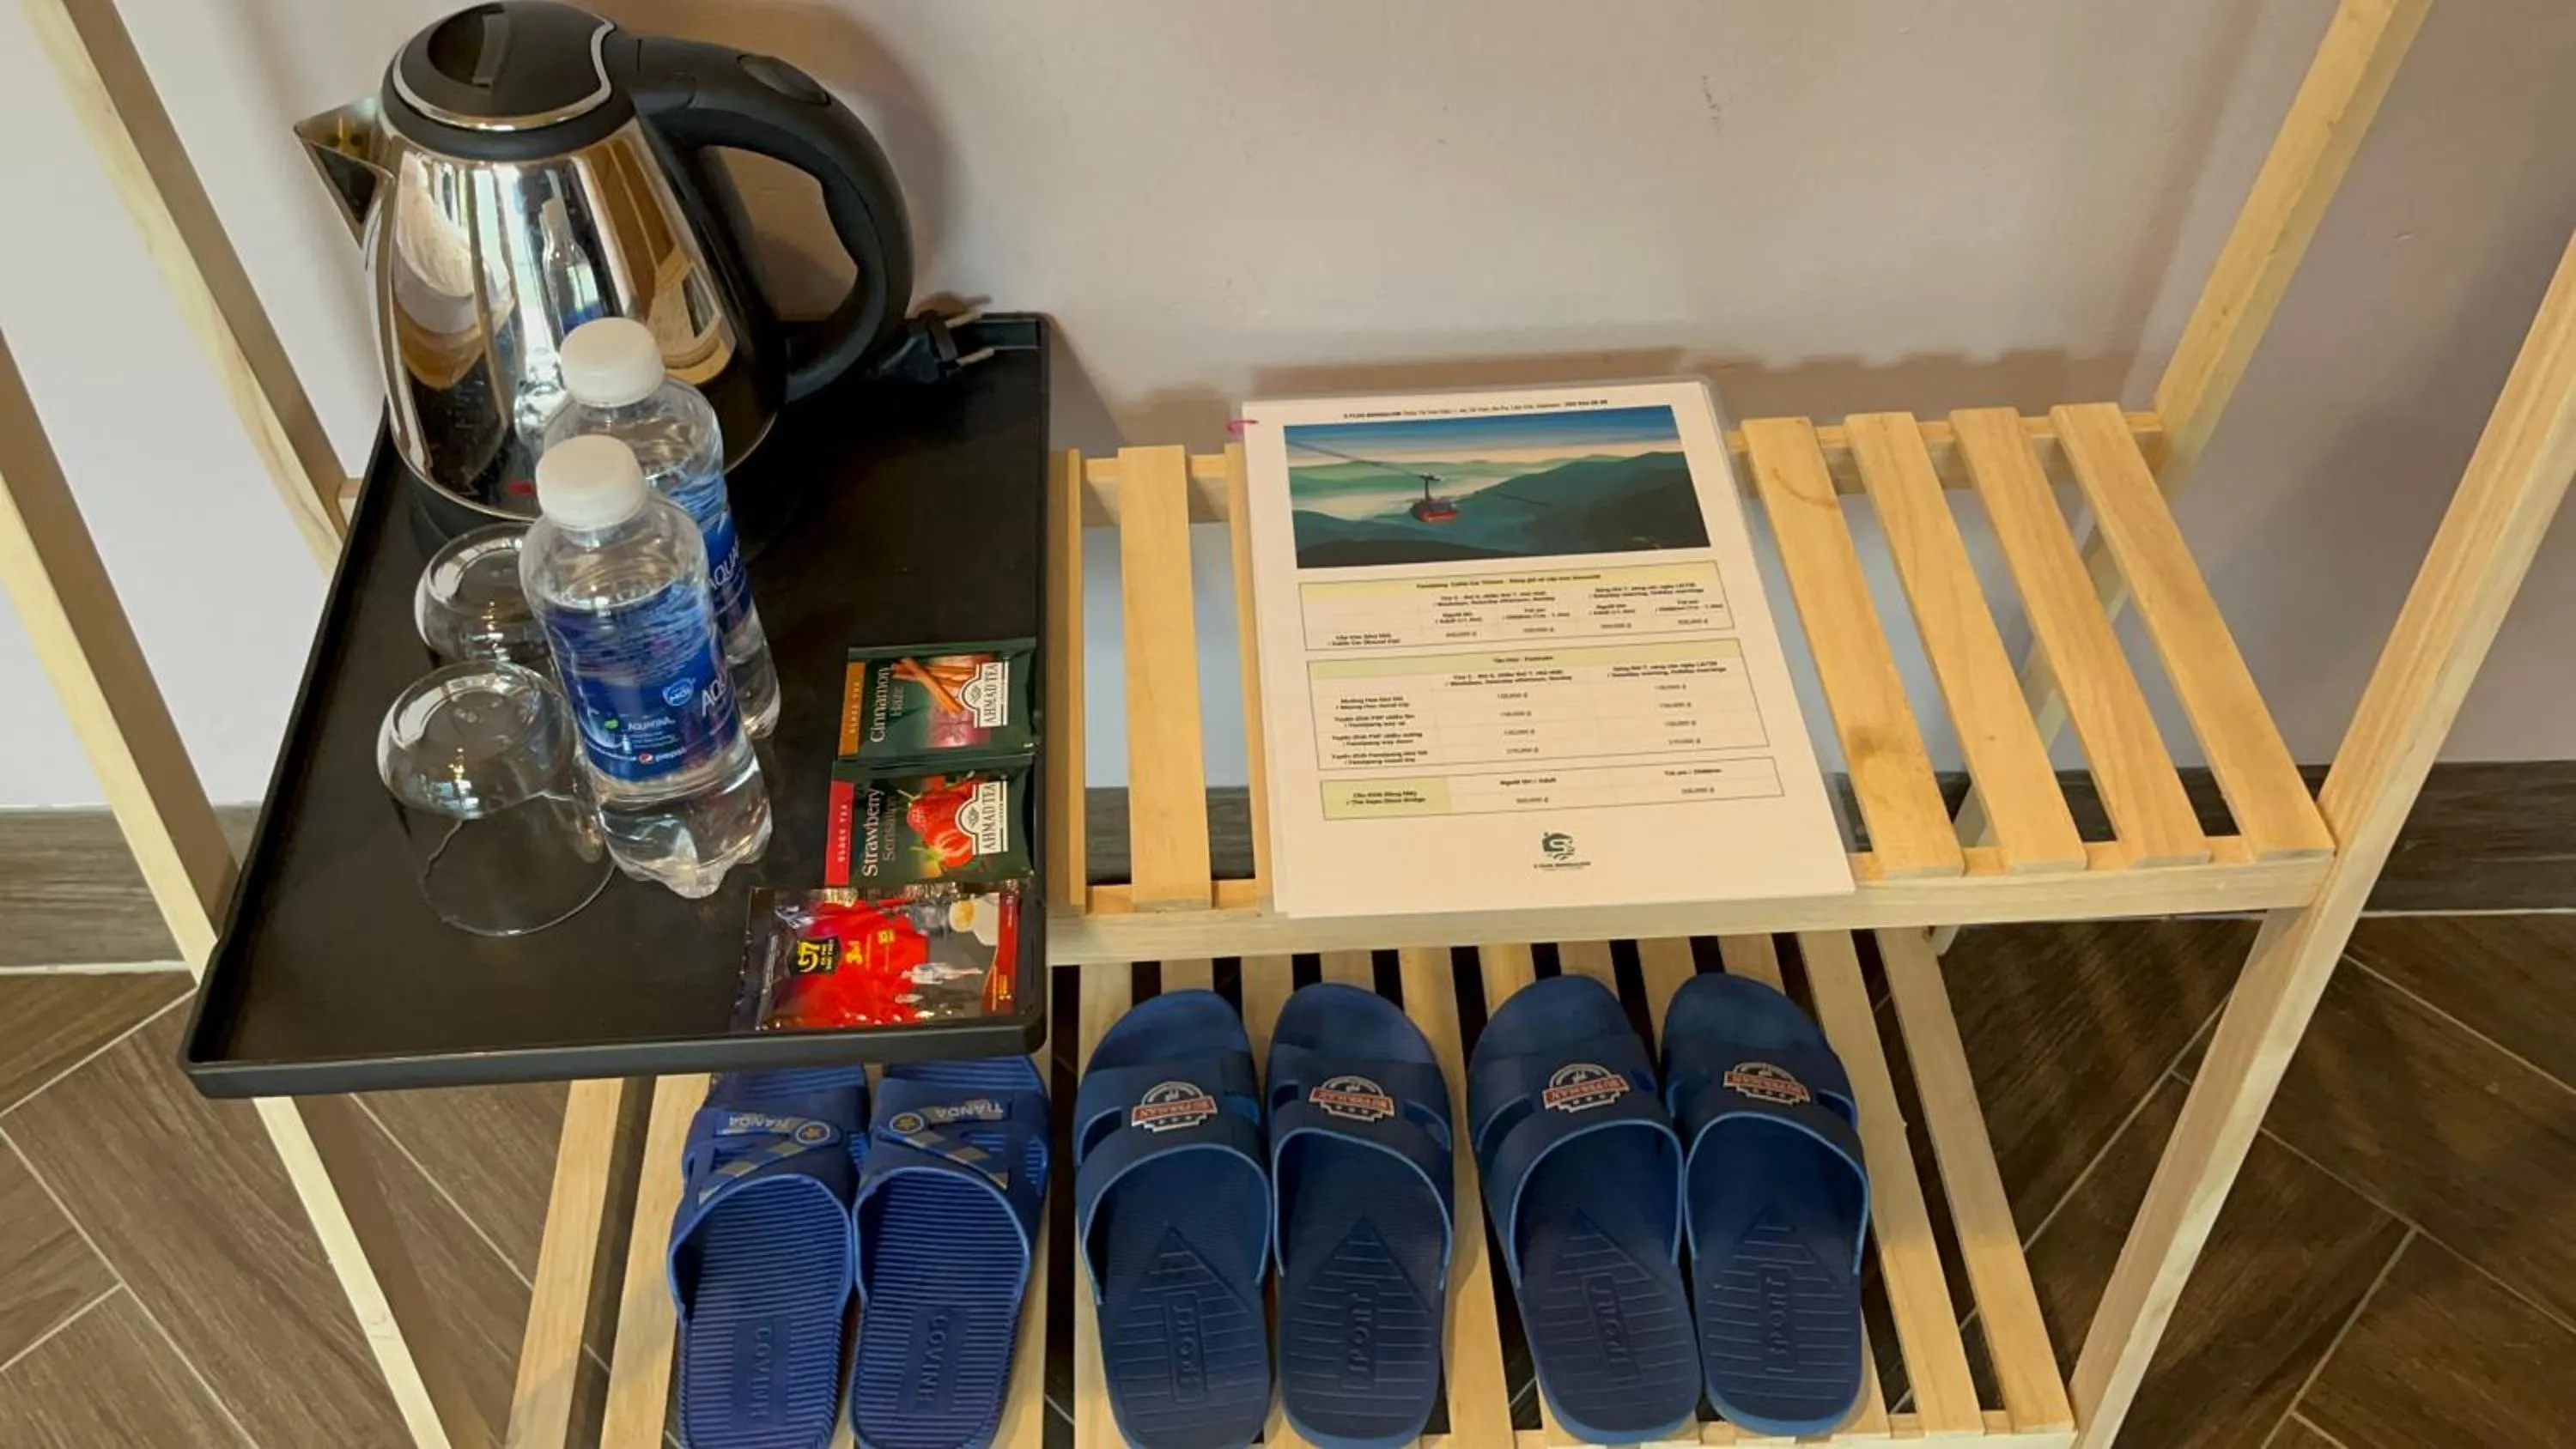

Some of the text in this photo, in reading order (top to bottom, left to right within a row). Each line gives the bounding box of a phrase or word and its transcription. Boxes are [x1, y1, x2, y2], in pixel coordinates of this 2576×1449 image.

[870, 666, 893, 743] Cinnamon
[983, 664, 998, 723] AHMAD TEA
[861, 787, 885, 876] Strawberry
[981, 783, 997, 851] AHMAD TEA
[934, 1099, 1005, 1119] TIANDA
